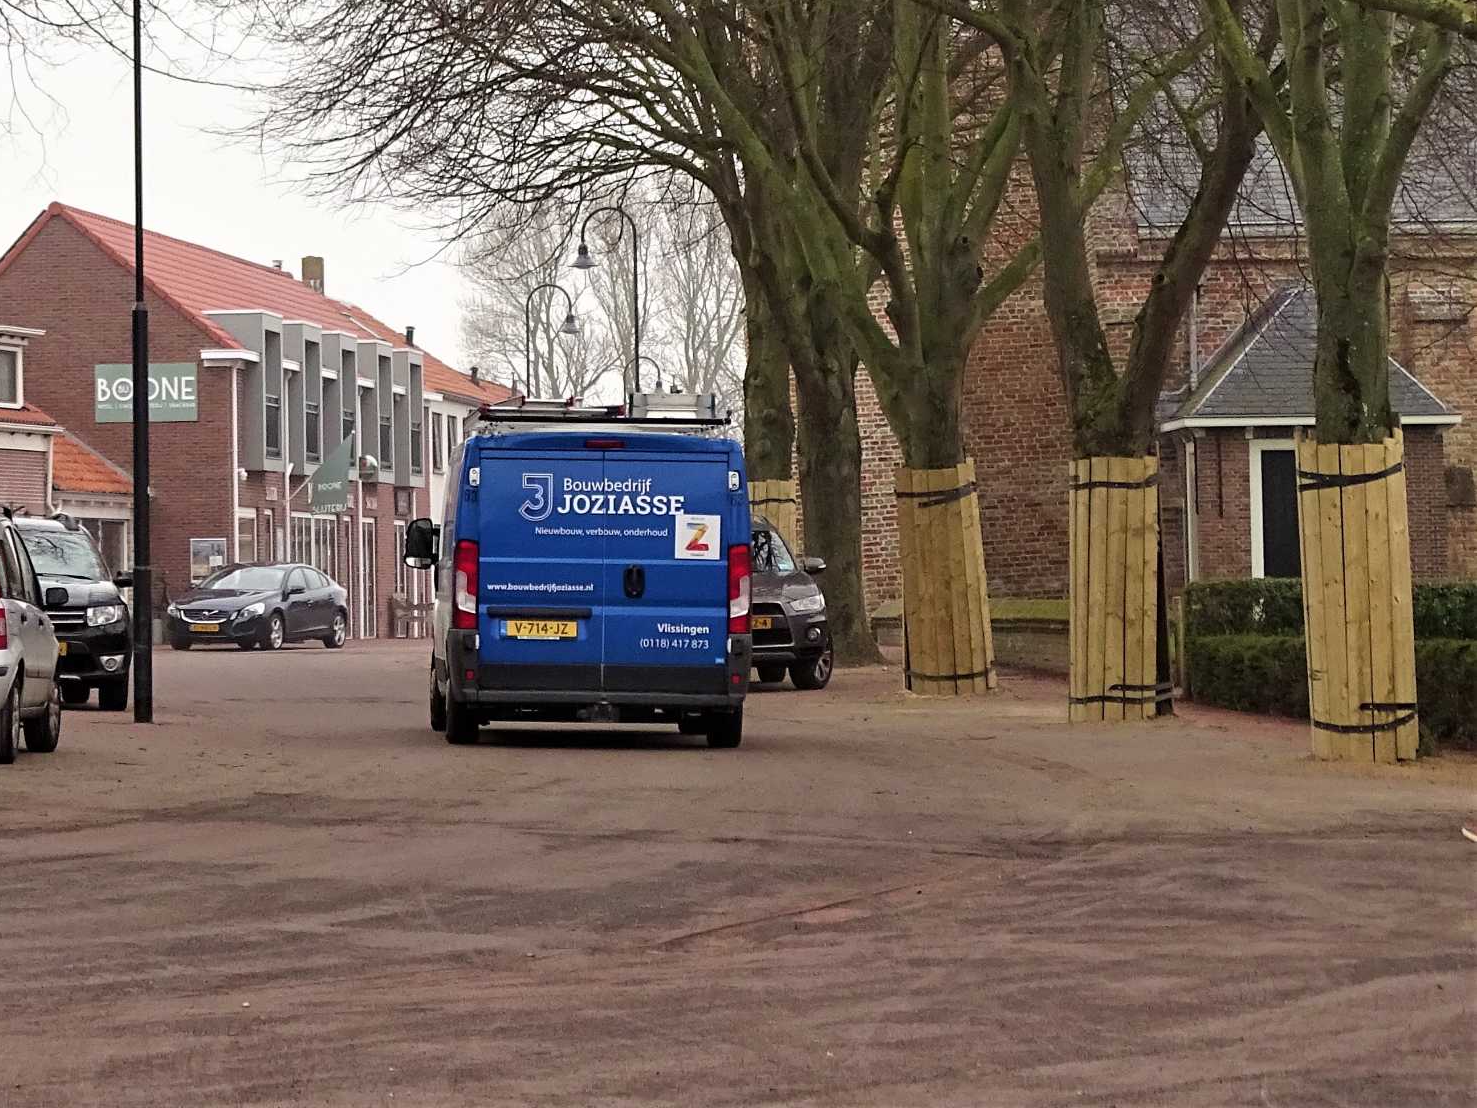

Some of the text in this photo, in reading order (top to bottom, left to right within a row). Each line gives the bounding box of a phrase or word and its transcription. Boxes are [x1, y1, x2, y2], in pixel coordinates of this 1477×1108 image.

[563, 477, 652, 494] Bouwbedrijf
[557, 494, 684, 515] JOZIASSE
[535, 527, 668, 537] Nieuwbouw, verbouw, onderhoud
[487, 583, 594, 593] www.bouwbedrijfjoziasse.nl
[515, 623, 568, 634] V-714-JZ
[657, 623, 710, 636] Vlissingen
[640, 638, 709, 650] (0118) 417 873
